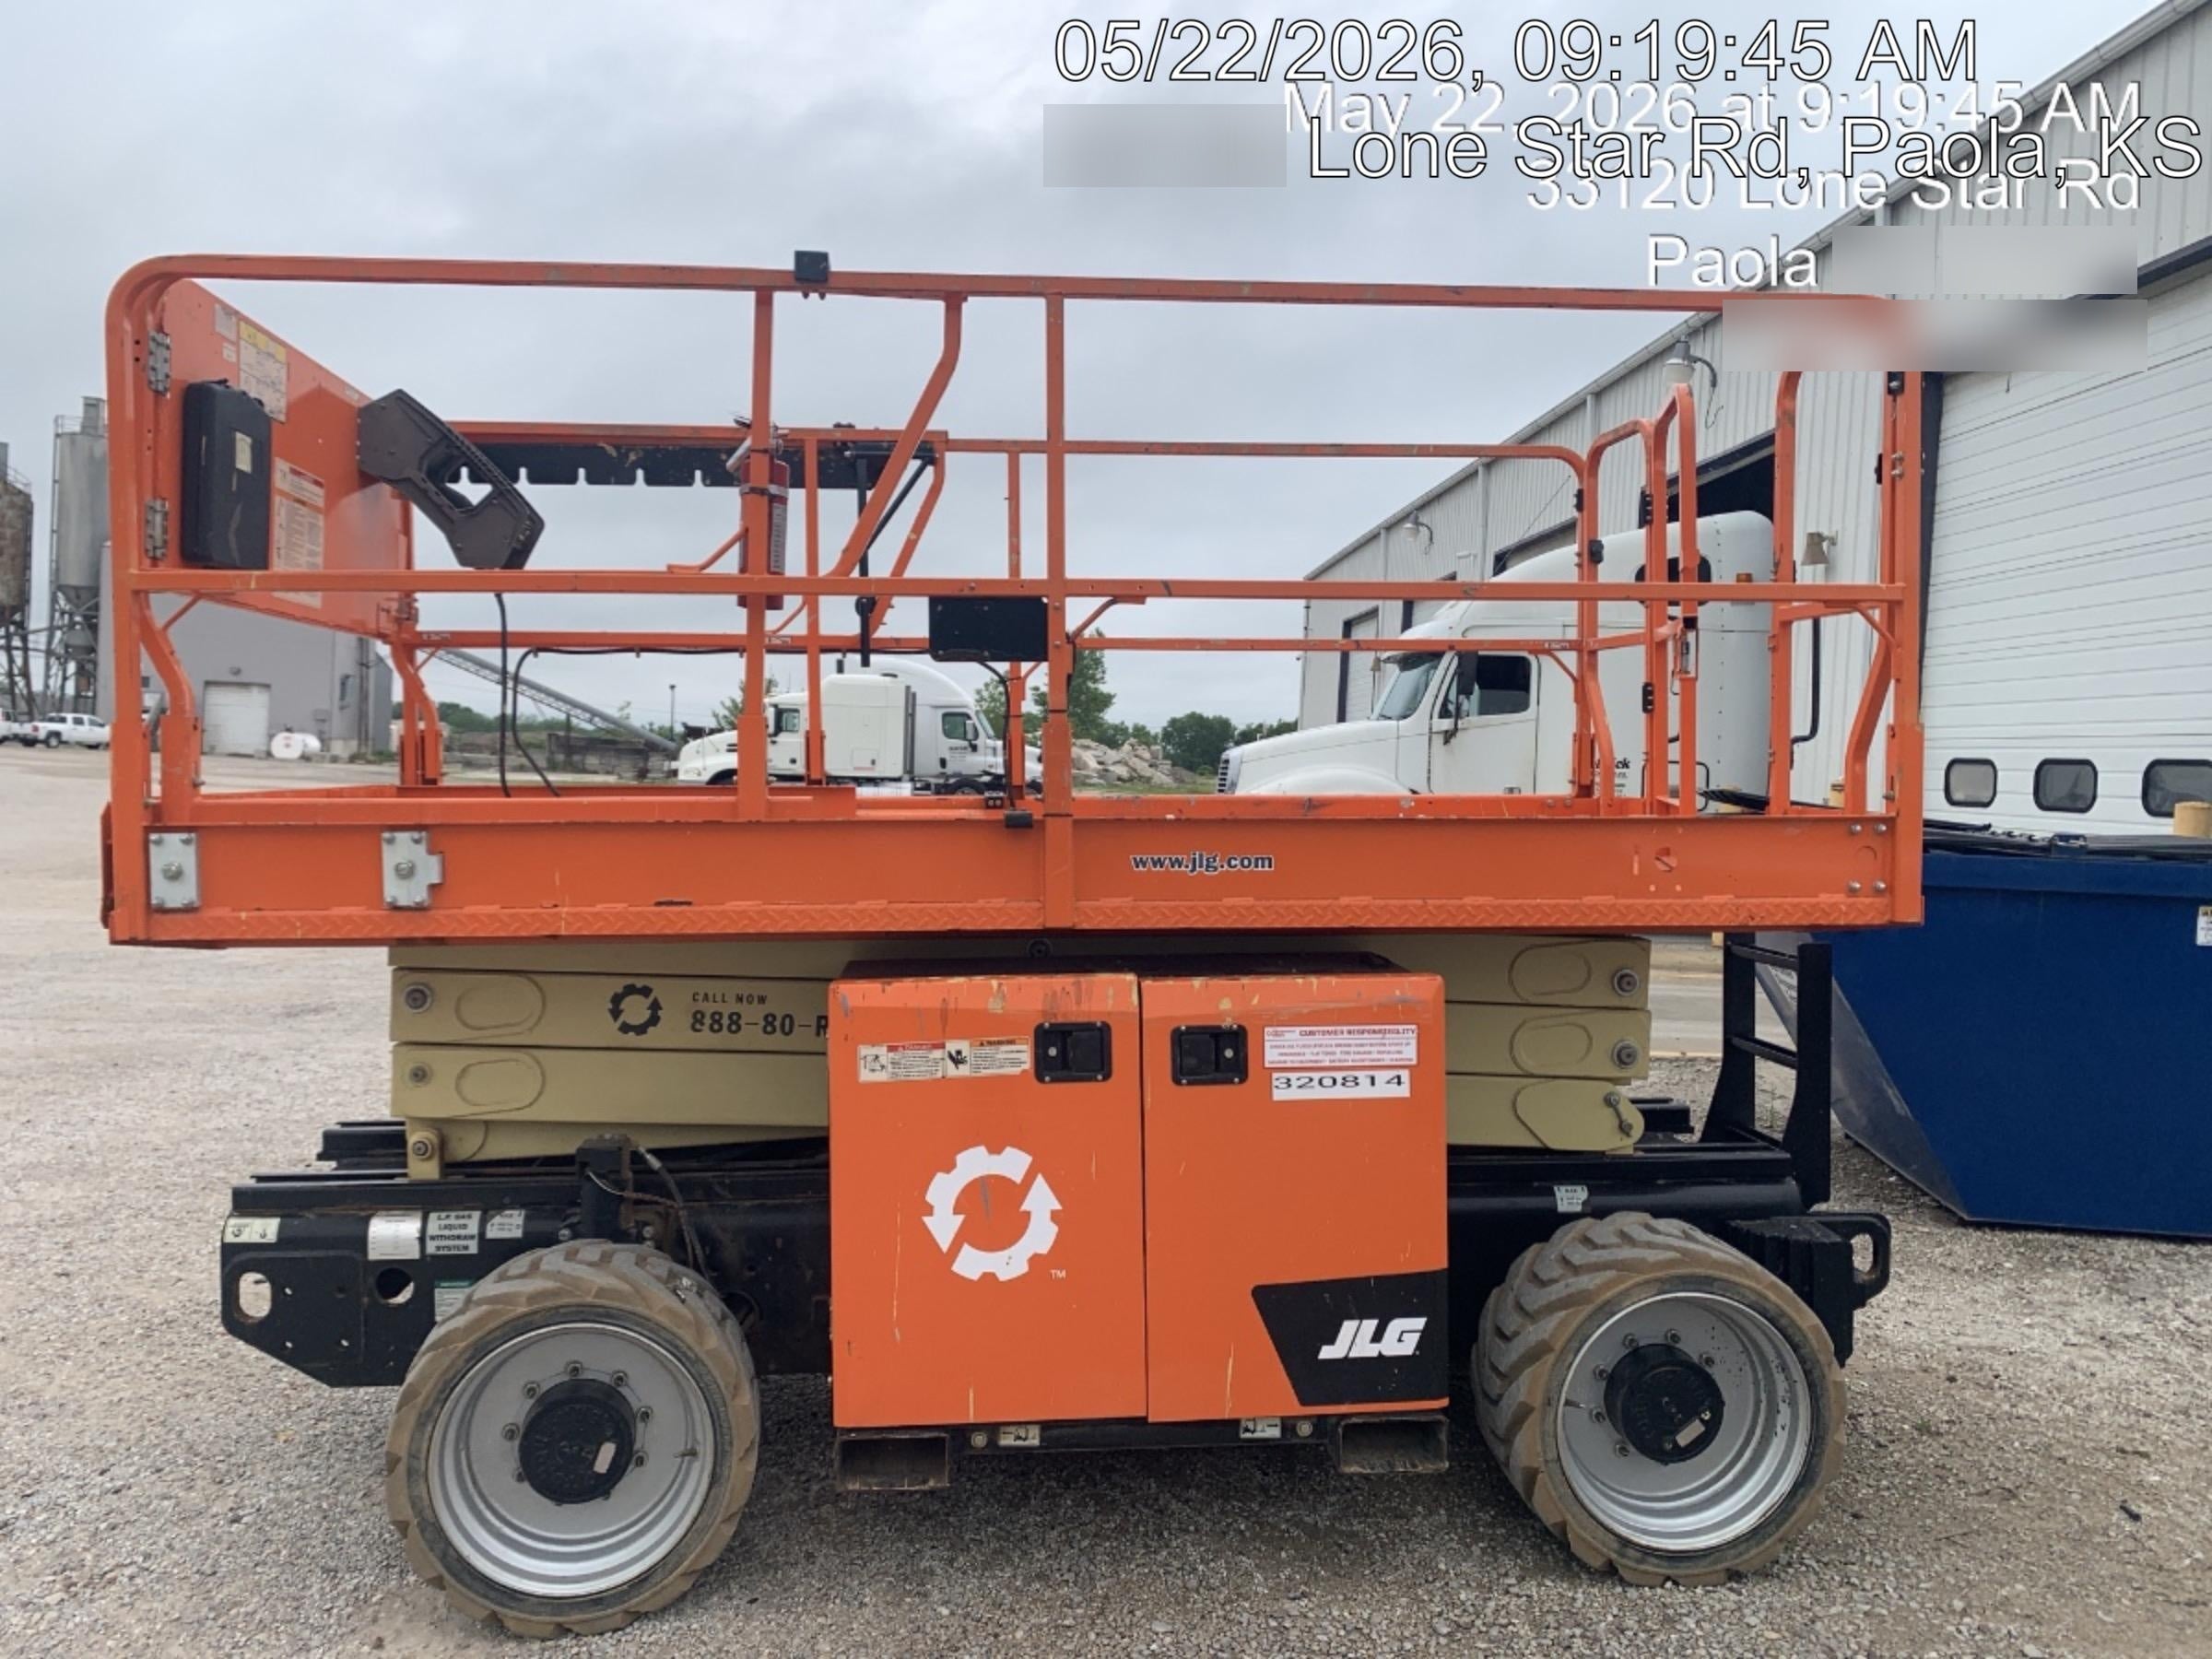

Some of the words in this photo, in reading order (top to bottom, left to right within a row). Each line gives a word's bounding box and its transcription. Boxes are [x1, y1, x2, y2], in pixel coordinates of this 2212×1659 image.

[1131, 851, 1274, 876] www.jlg.com
[692, 992, 728, 1004] CALL
[735, 993, 768, 1006] NOW
[1274, 1074, 1406, 1090] 320814
[1317, 1317, 1428, 1359] JLG
